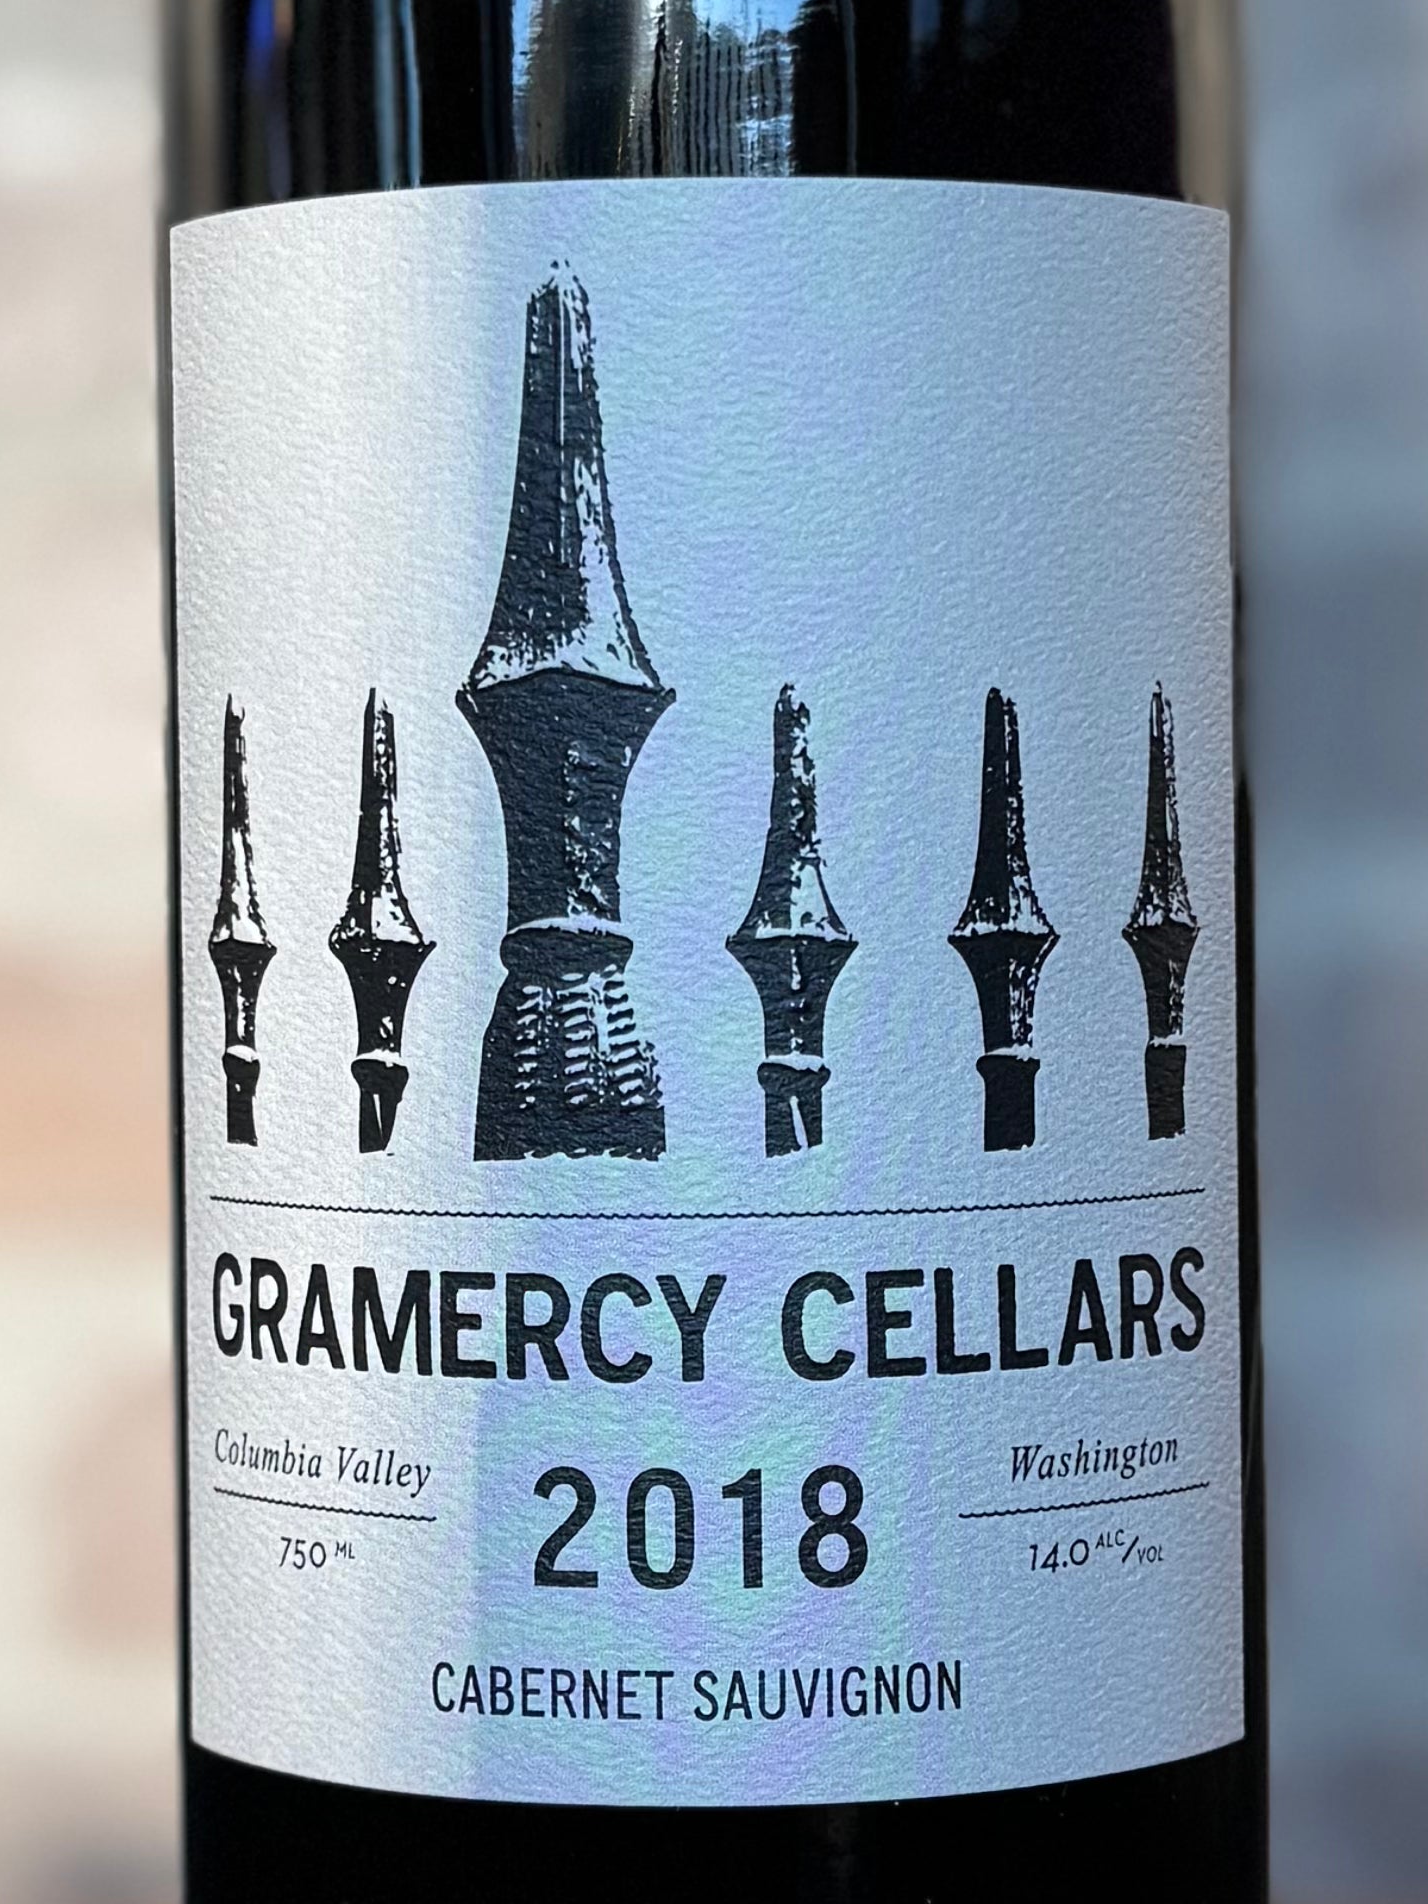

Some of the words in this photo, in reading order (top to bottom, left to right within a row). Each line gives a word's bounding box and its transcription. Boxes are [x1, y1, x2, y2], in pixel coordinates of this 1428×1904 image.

[212, 1251, 727, 1384] GRAMERCY
[781, 1246, 1207, 1379] CELLARS
[214, 1428, 322, 1479] Columbia
[337, 1445, 432, 1499] Valley
[1009, 1437, 1178, 1483] Washington
[278, 1536, 327, 1570] 750
[333, 1541, 356, 1561] ML
[532, 1464, 870, 1590] 2018
[1028, 1538, 1090, 1574] 14.0
[431, 1660, 675, 1721] CABERNET
[692, 1658, 965, 1721] SAUVIGNON
